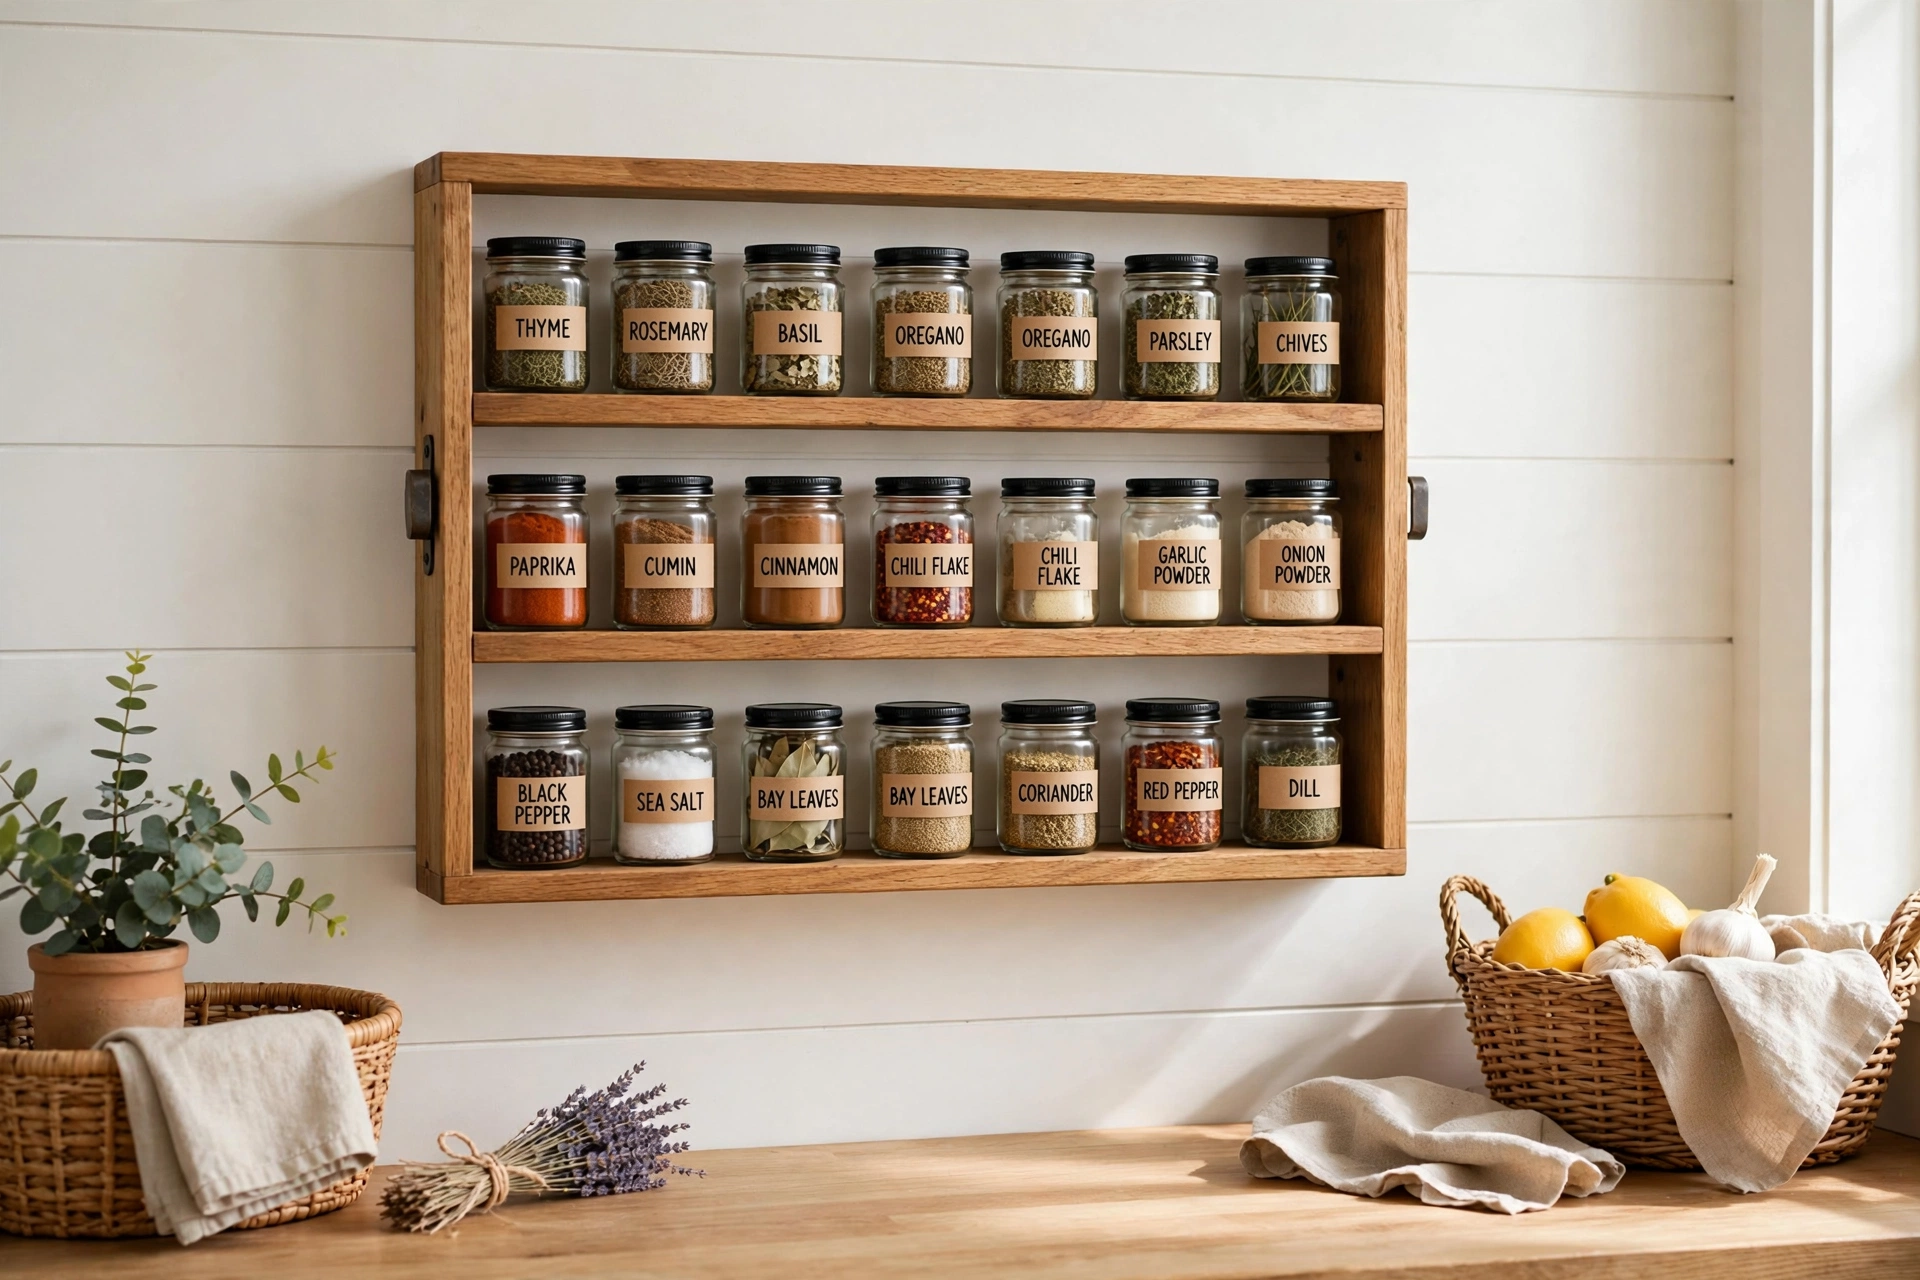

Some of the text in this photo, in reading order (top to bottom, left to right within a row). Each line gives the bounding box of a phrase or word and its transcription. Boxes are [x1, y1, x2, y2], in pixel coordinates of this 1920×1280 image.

[515, 317, 571, 339] THYME
[629, 320, 709, 342] ROSEMARY
[778, 322, 823, 344] BASIL
[895, 325, 965, 346] OREGANO
[1022, 328, 1091, 349] OREGANO
[1149, 331, 1212, 352] PARSLEY
[1276, 333, 1328, 353] CHIVES
[1040, 546, 1077, 566] CHILI
[1158, 545, 1207, 565] GARLIC
[1281, 544, 1325, 564] ONION
[510, 555, 576, 577] PAPRIKA
[644, 556, 696, 577] CUMIN
[760, 556, 839, 576] CINNAMON
[890, 556, 970, 576] CHILI FLAKE
[1037, 566, 1081, 586] FLAKE
[1154, 565, 1211, 585] POWDER
[1275, 565, 1332, 584] POWDER
[518, 782, 568, 804] BLACK
[889, 785, 968, 807] BAY LEAVES
[1018, 782, 1094, 803] CORIANDER
[1143, 780, 1219, 800] RED PEPPER
[1289, 778, 1321, 798] DILL
[636, 791, 705, 812] SEA SALT
[757, 788, 839, 810] BAY LEAVES
[514, 804, 571, 825] PEPPER
